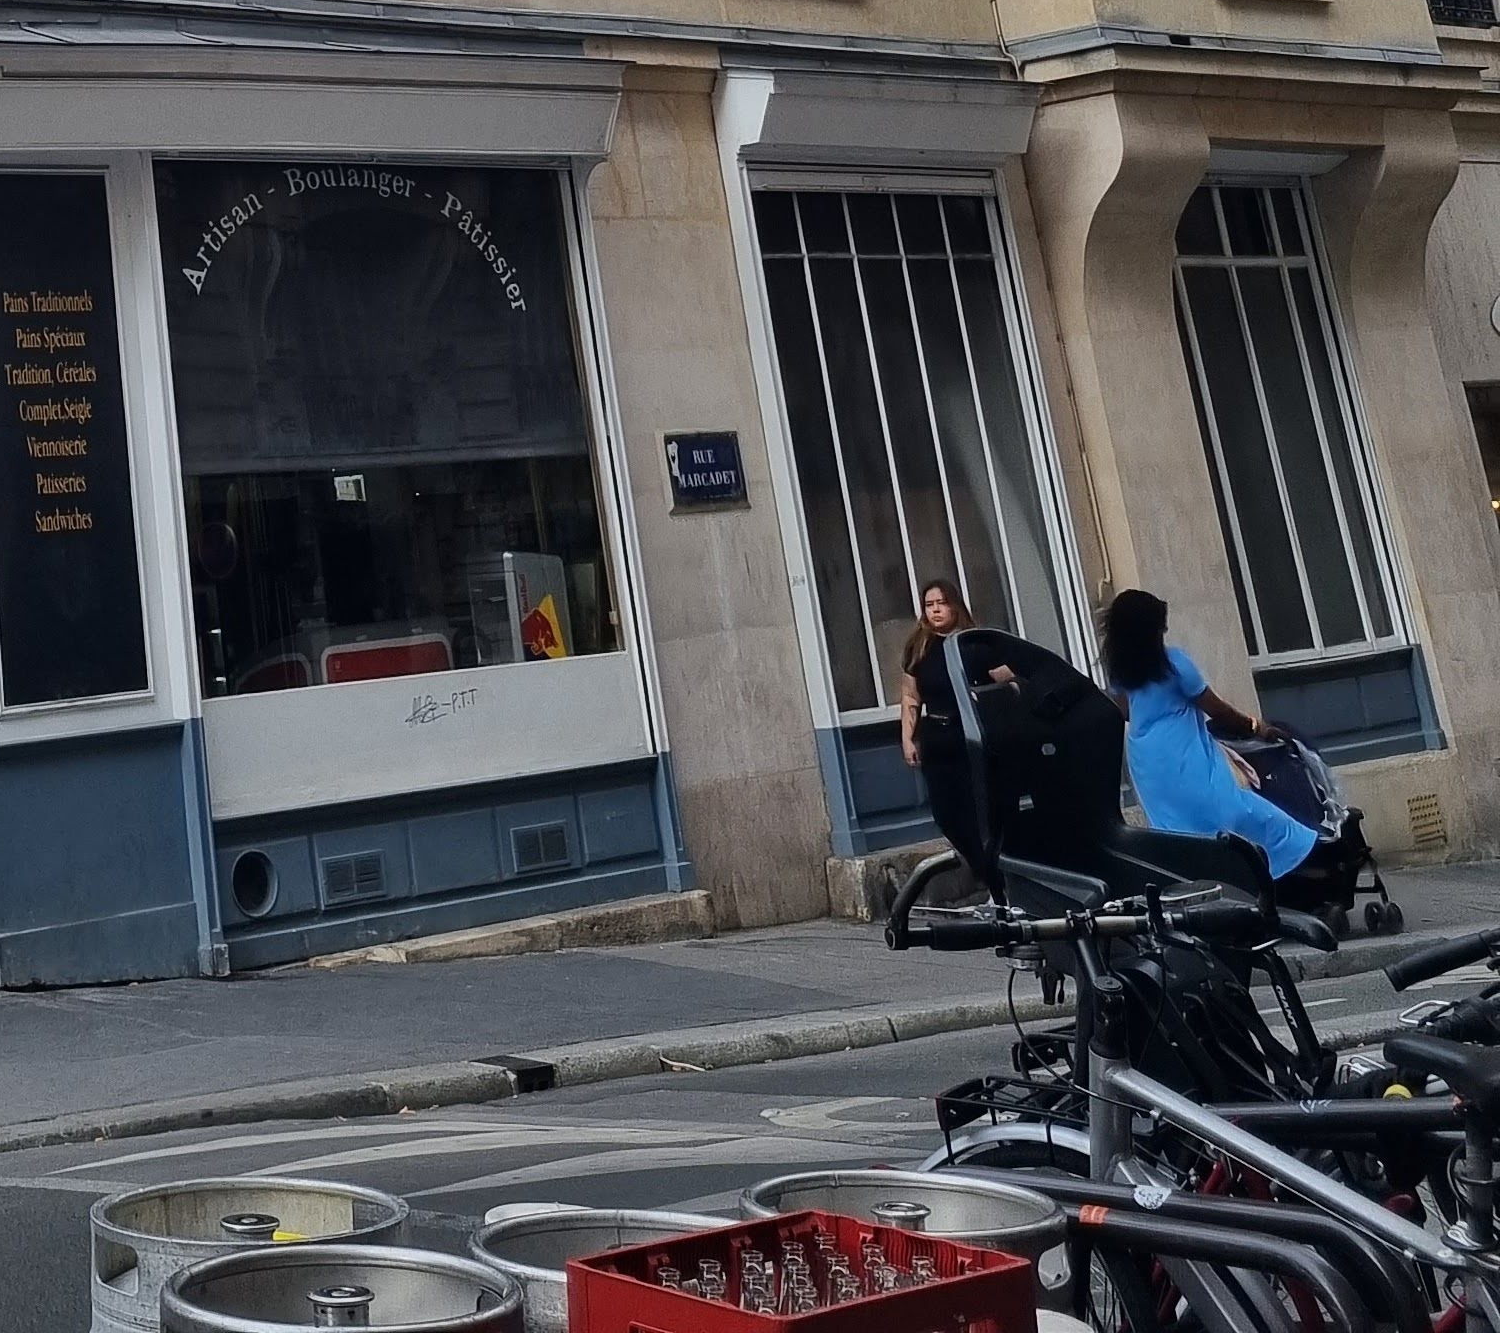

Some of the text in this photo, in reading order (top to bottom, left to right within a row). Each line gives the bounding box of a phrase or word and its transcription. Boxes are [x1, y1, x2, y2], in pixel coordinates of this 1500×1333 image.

[182, 192, 263, 295] Artisan
[283, 165, 416, 198] Boulanger
[440, 191, 527, 314] Pâtissier
[3, 289, 93, 313] Pains Traditionnels
[15, 326, 86, 354] Pains Spéciaux
[4, 360, 97, 387] Tradition, Céréales
[26, 434, 88, 458] Viennoiserie
[692, 449, 716, 465] RUE
[36, 472, 87, 495] Patisseries
[678, 470, 736, 489] MARCADET
[35, 506, 93, 533] Sandwiches
[1275, 984, 1298, 1029] GIANT
